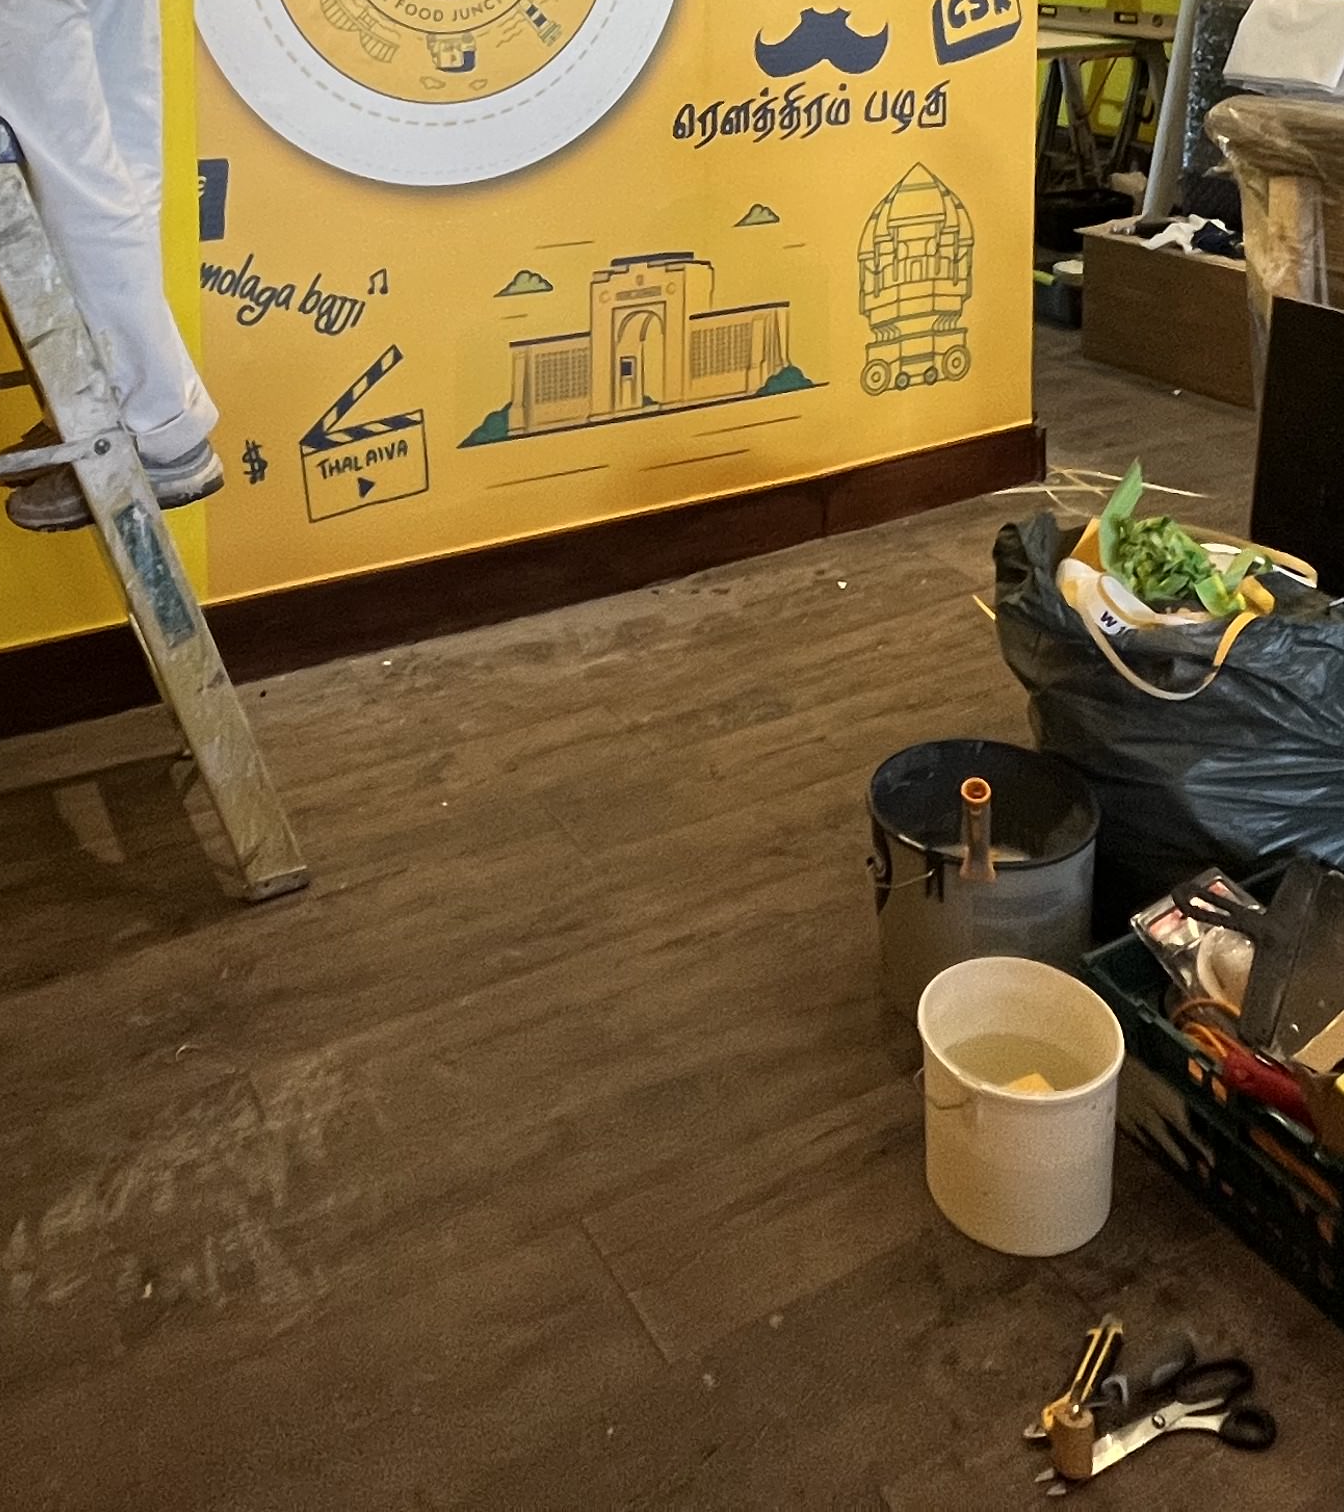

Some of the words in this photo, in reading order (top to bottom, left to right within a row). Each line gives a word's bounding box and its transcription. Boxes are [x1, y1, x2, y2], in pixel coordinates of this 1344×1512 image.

[395, 0, 444, 23] FOOD
[200, 253, 297, 326] molaga
[315, 439, 409, 479] THALAIVA
